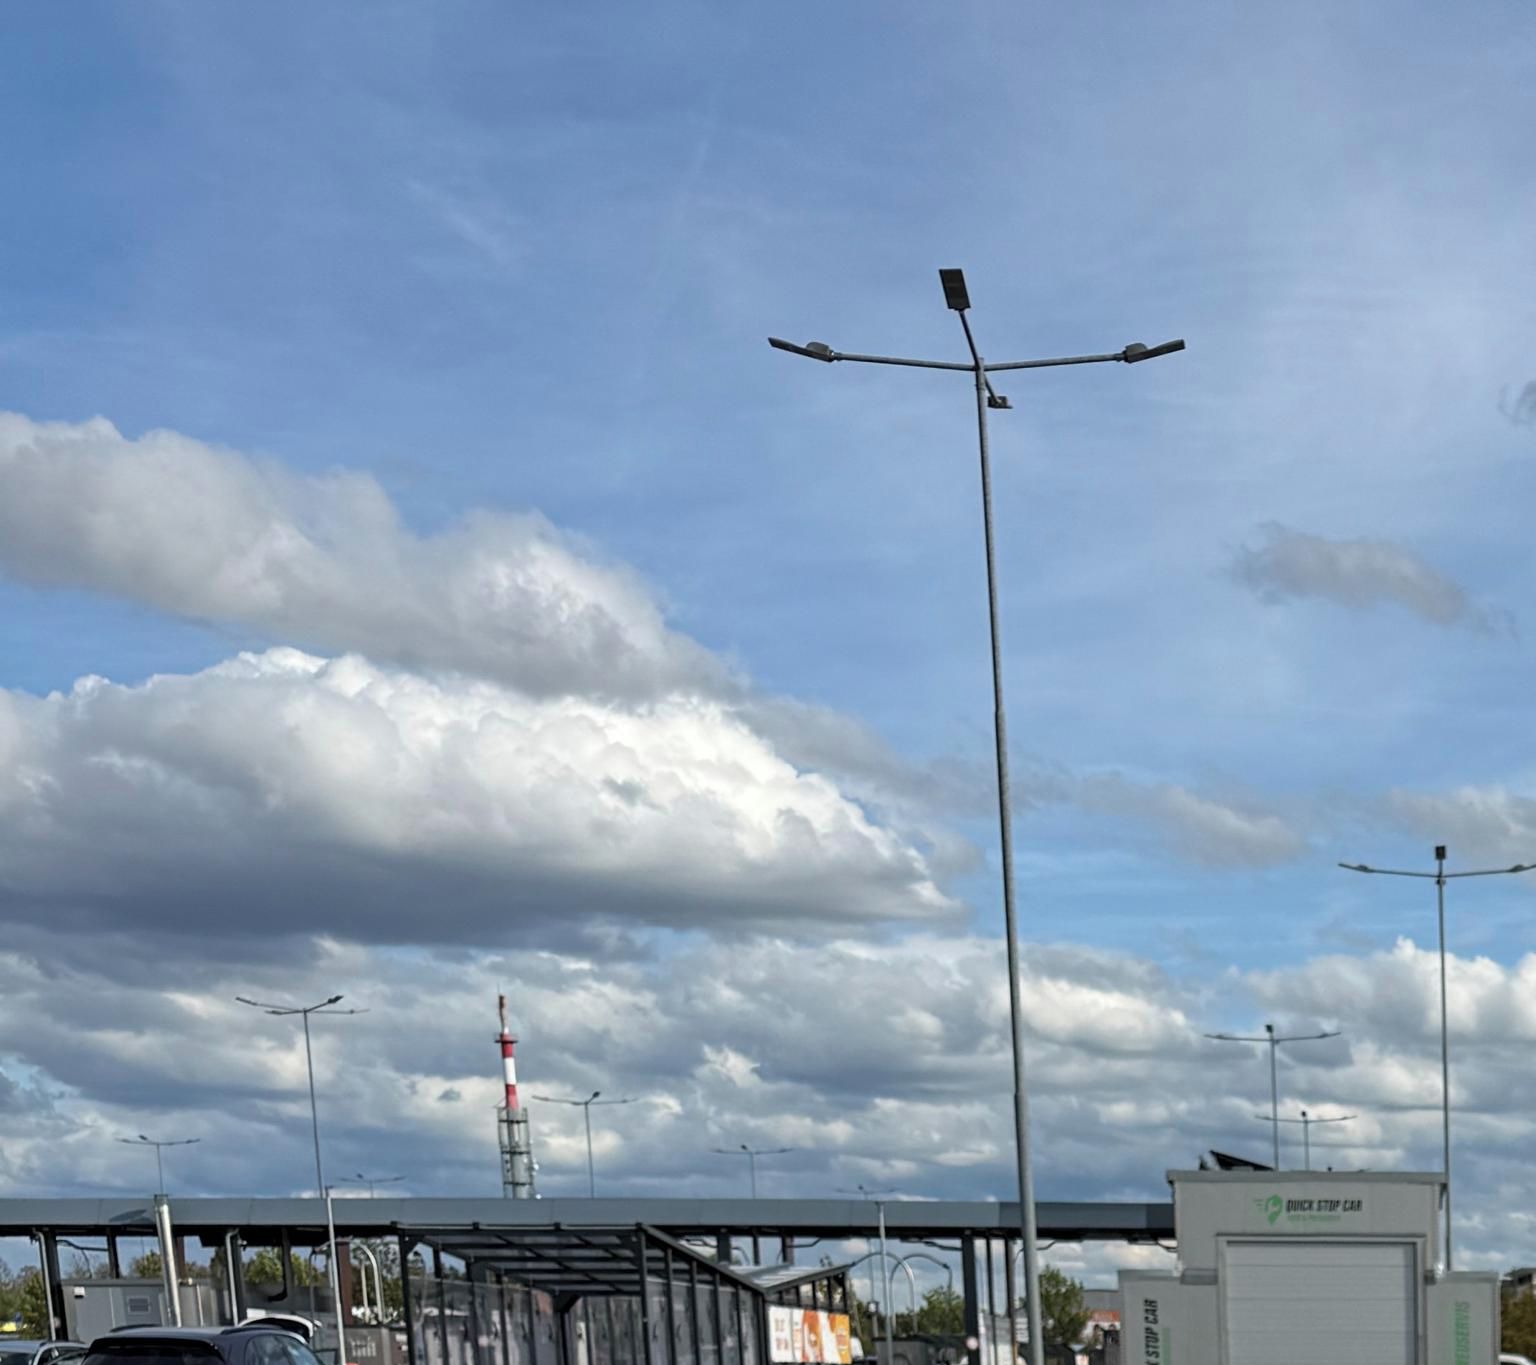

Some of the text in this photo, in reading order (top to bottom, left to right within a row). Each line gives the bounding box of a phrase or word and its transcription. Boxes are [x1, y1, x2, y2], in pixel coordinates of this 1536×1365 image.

[1286, 1199, 1363, 1212] QUICK STOP CAR
[1143, 1299, 1159, 1325] CAR
[1144, 1327, 1160, 1359] STOP
